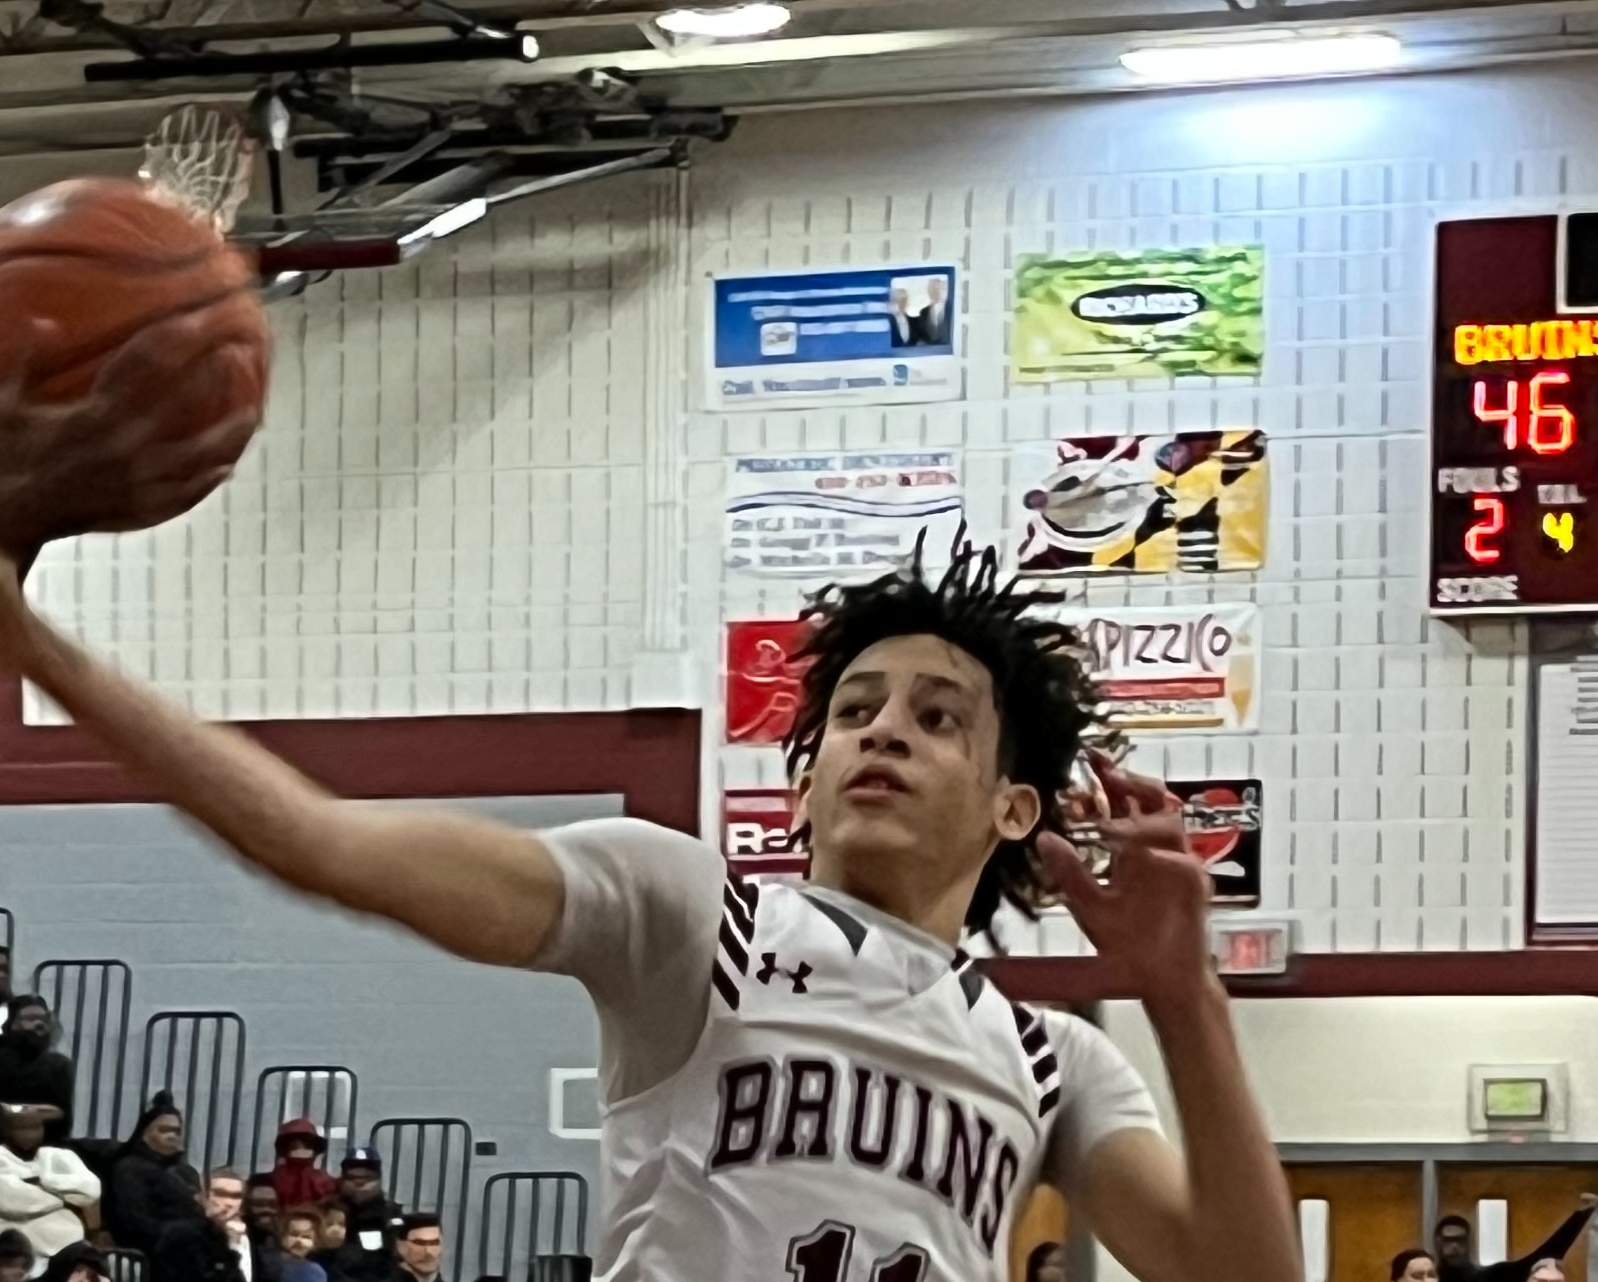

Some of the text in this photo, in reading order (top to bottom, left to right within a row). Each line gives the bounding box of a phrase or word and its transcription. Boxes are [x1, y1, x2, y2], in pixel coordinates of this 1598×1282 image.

[1455, 320, 1598, 365] BRUIN
[1473, 371, 1575, 454] 46
[1464, 497, 1504, 563] 2
[1542, 512, 1574, 553] 4
[705, 1054, 1020, 1259] BRUINS
